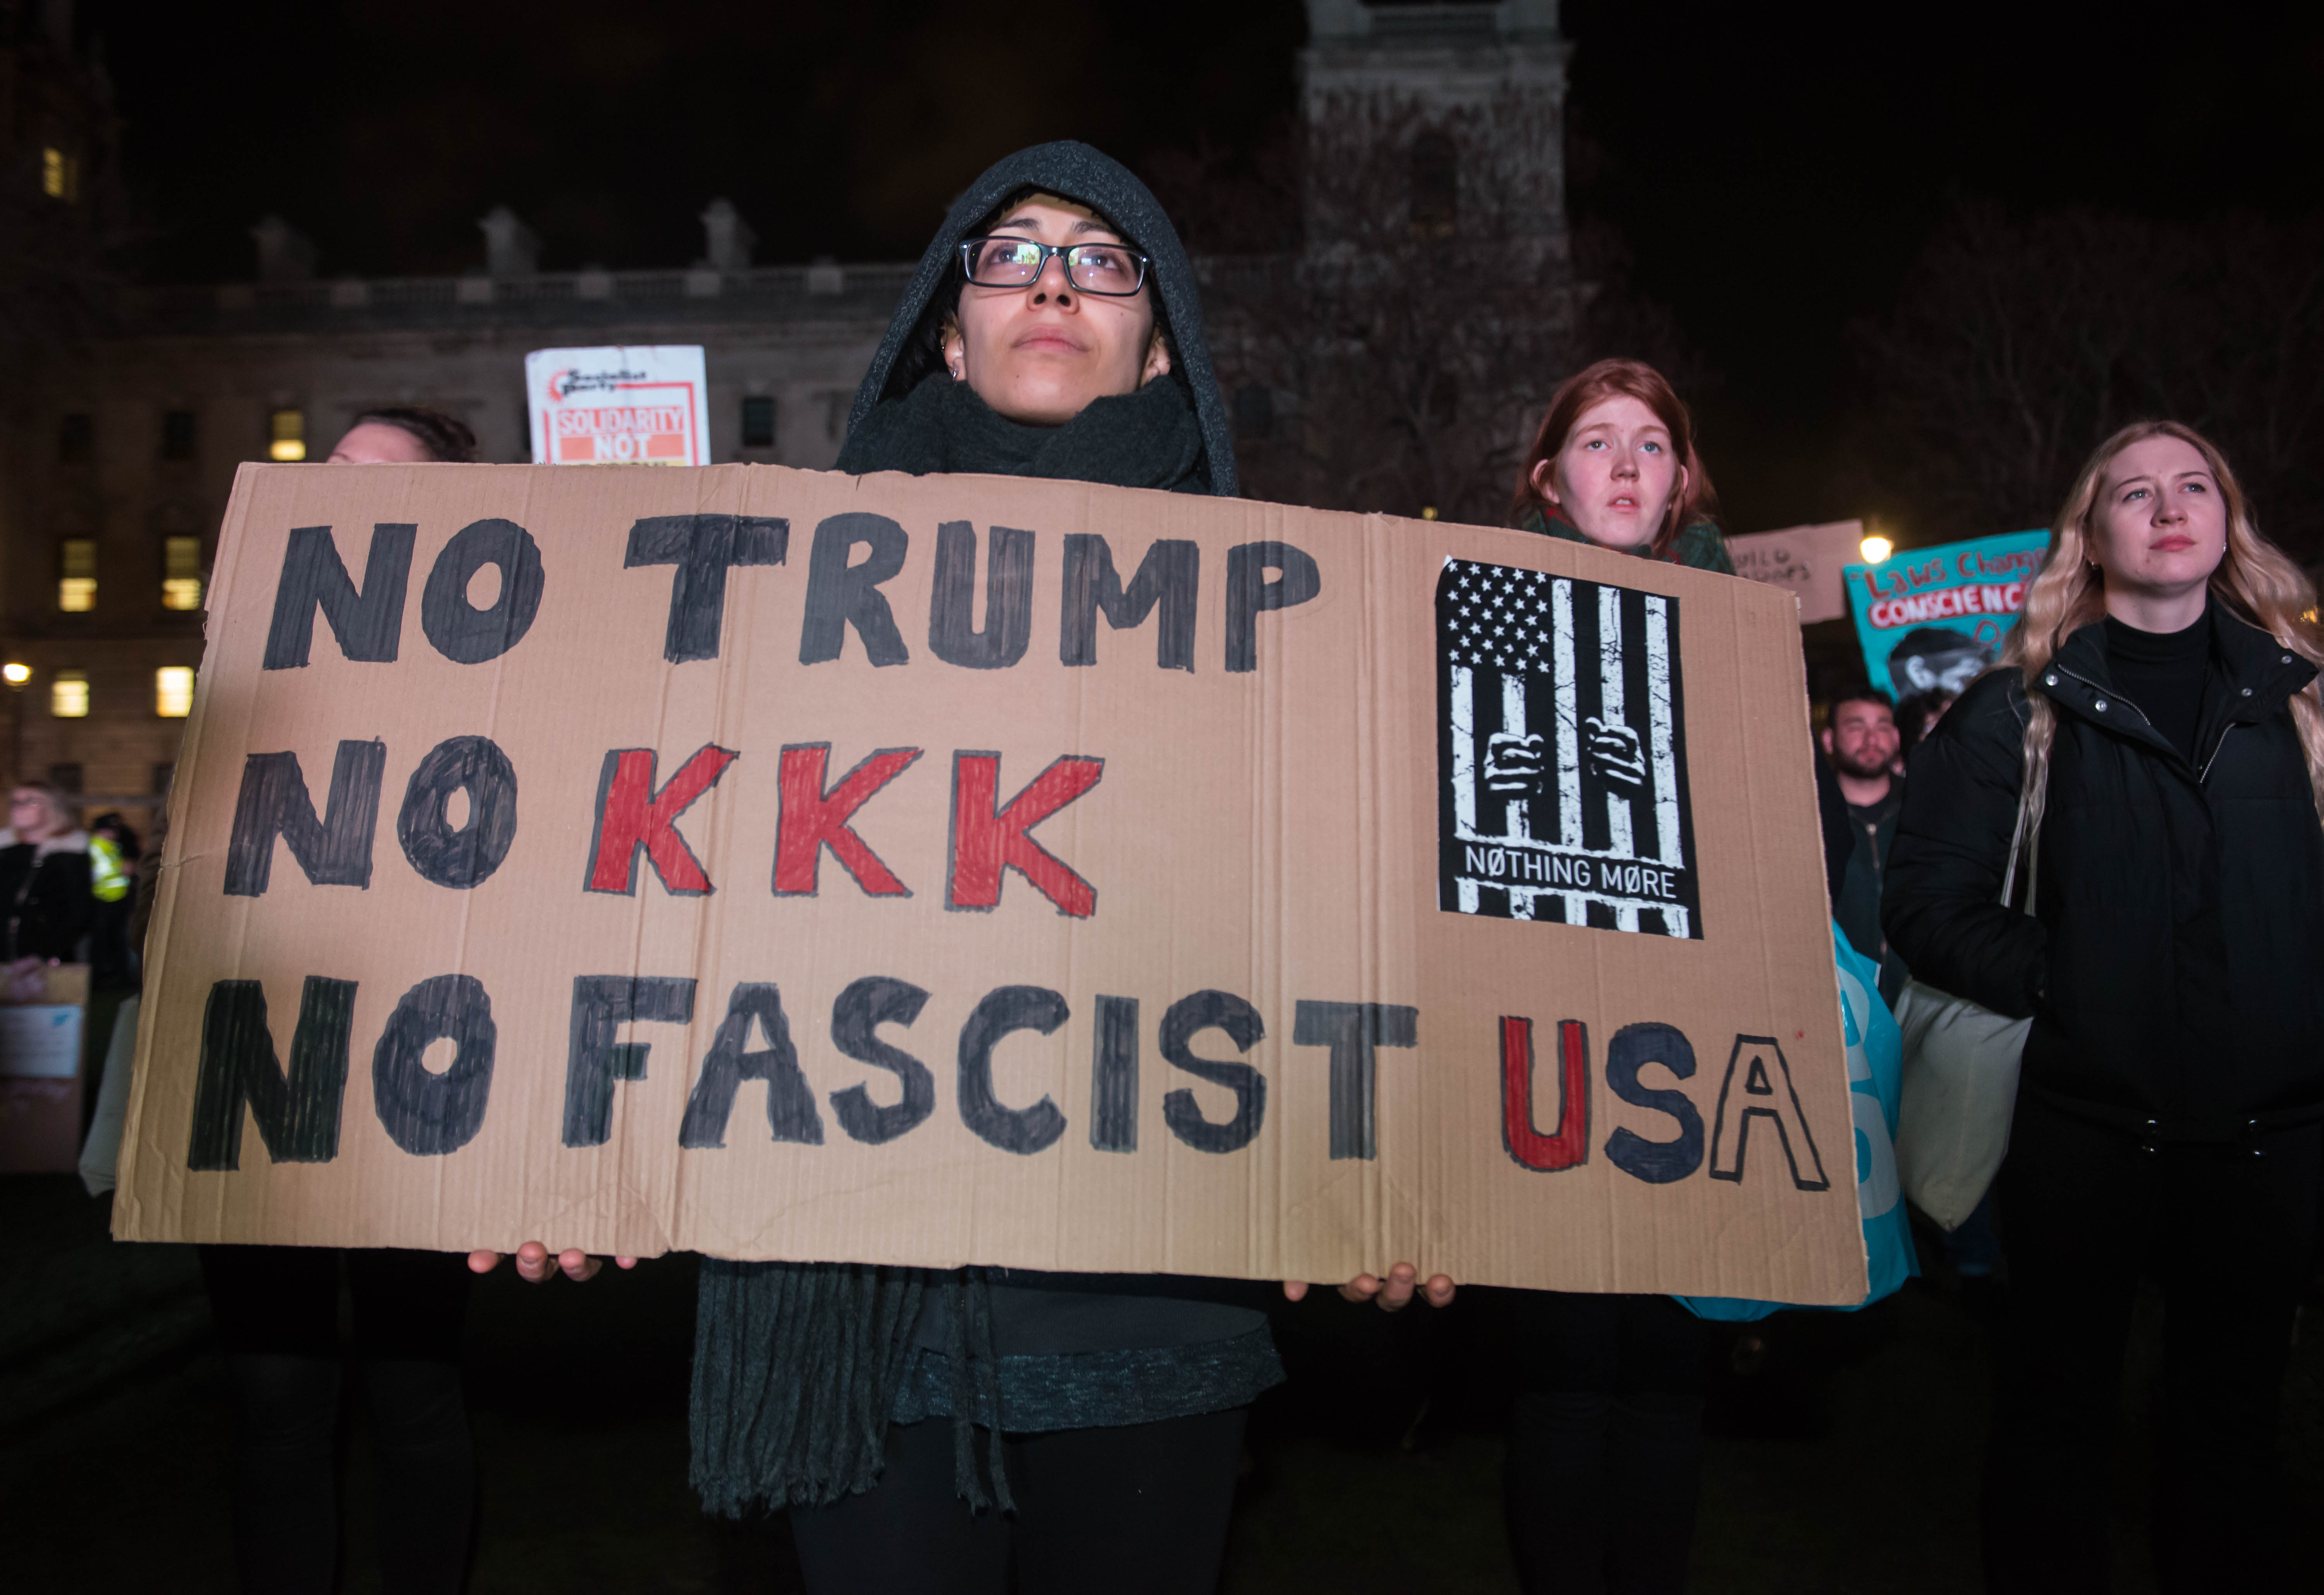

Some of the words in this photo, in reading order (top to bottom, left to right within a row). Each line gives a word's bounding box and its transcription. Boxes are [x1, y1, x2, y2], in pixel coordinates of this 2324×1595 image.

[560, 408, 683, 433] SOLIDARITY
[594, 433, 651, 459] NOT
[263, 517, 545, 670] NO
[624, 512, 1321, 674] TRUMP
[1870, 583, 2029, 628] CONSCIENC
[223, 735, 517, 897] NO
[583, 742, 1105, 919] KKK
[187, 974, 497, 1172] NO
[561, 975, 1420, 1161] FASCIST
[1499, 1015, 1831, 1192] USA
